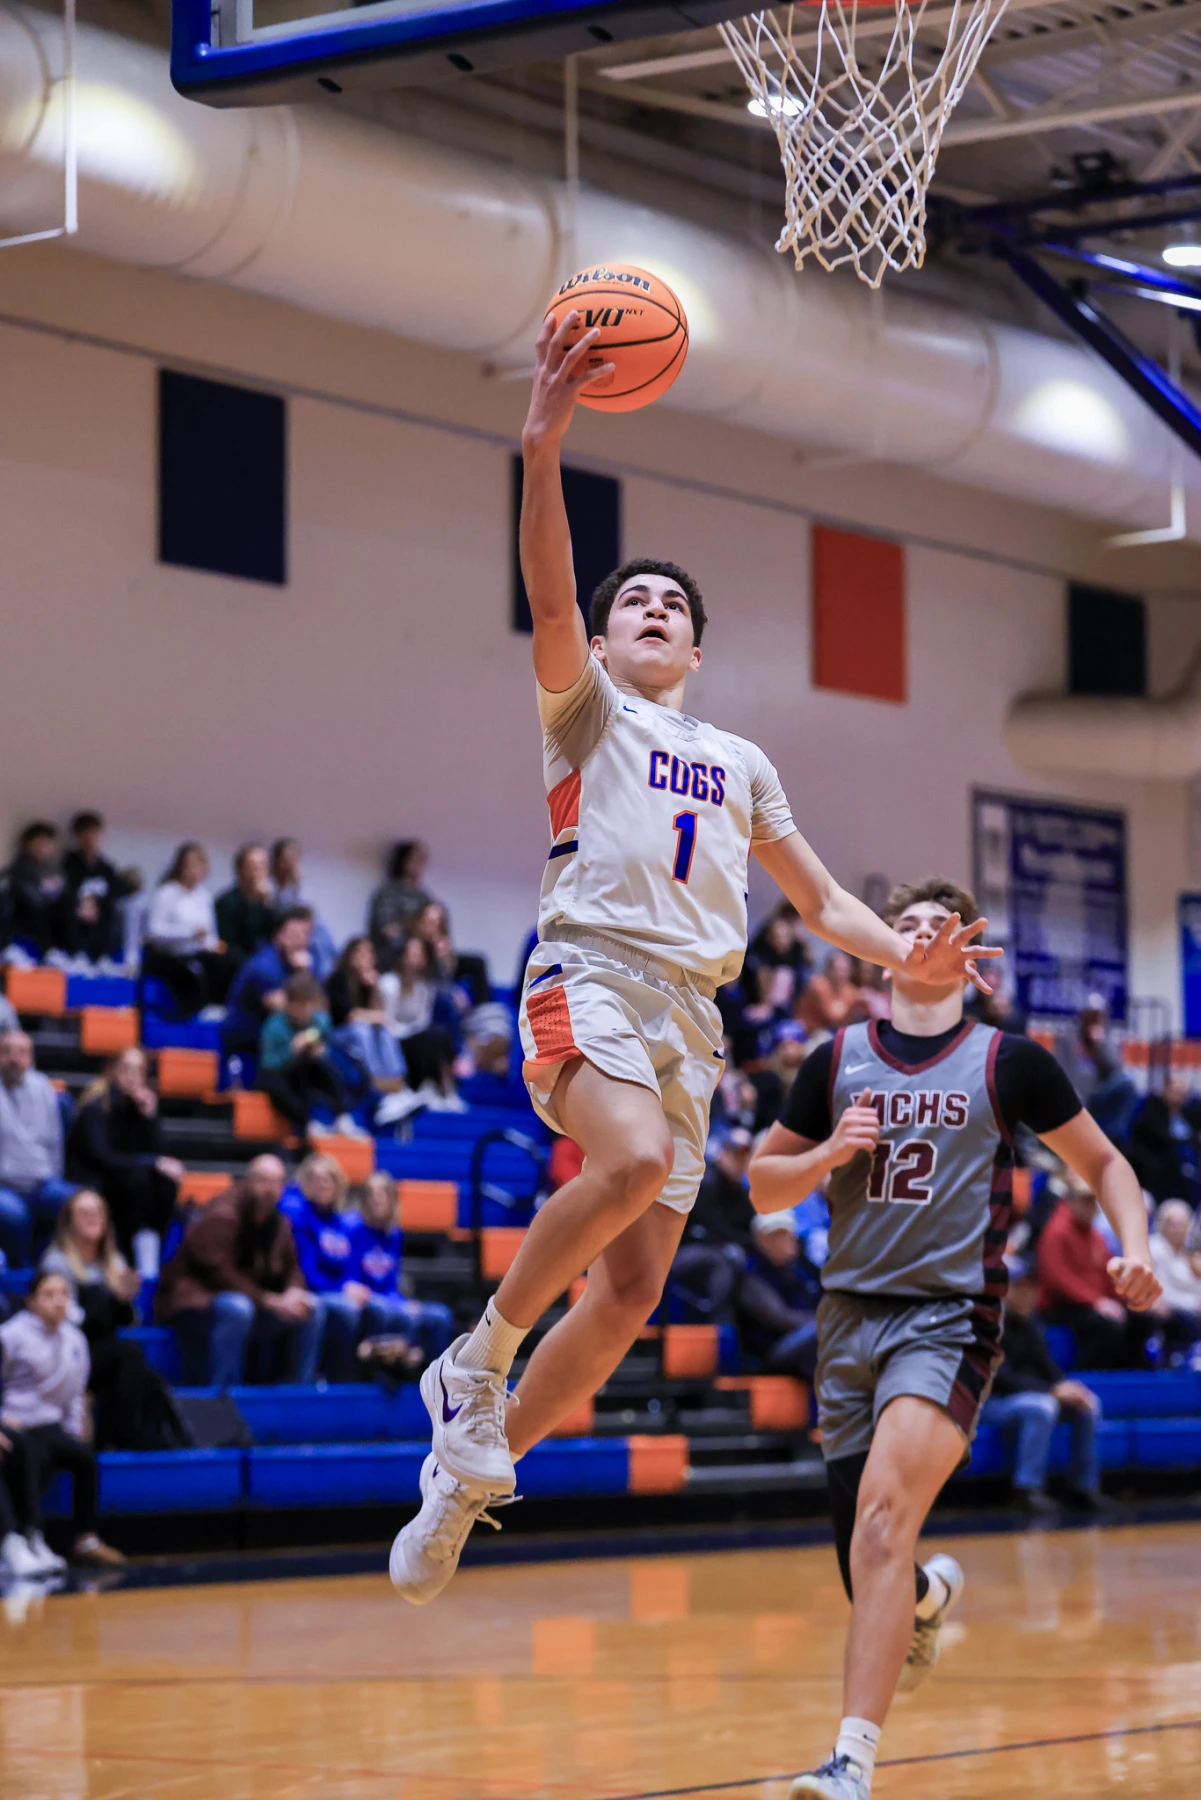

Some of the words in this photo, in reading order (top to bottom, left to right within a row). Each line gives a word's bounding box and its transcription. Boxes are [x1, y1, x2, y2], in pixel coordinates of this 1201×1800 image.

[558, 267, 651, 295] Wilson
[625, 308, 645, 317] NXT
[648, 749, 726, 808] COGS
[672, 809, 698, 885] 1
[866, 1138, 938, 1205] 12
